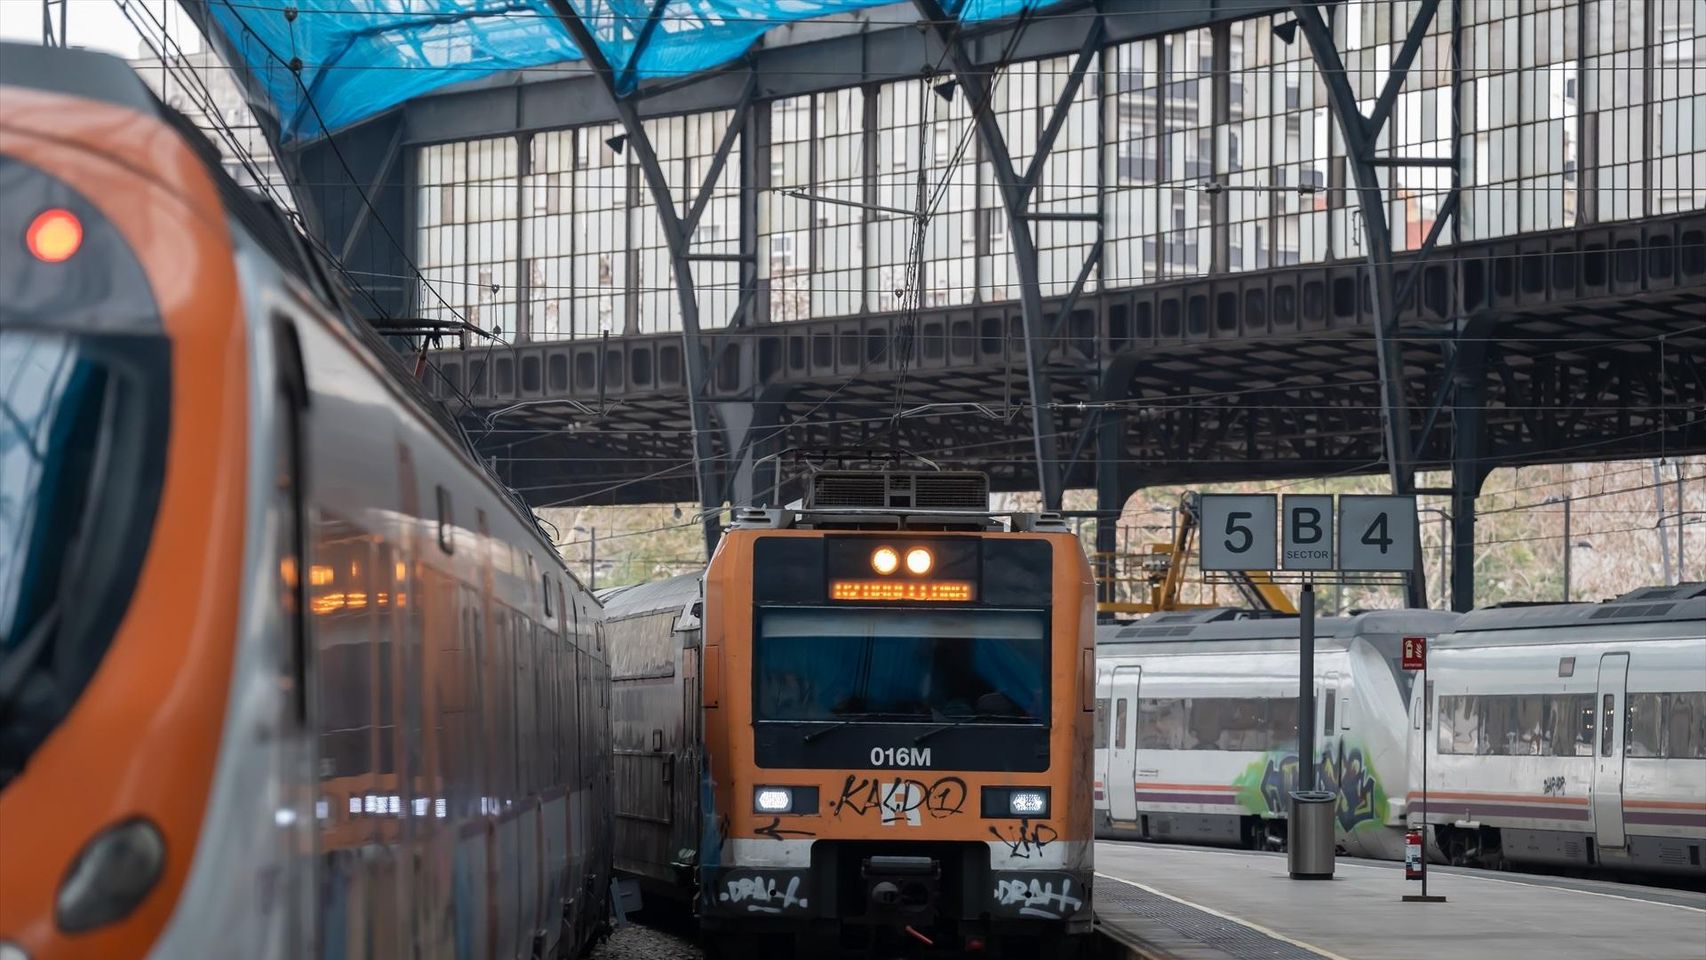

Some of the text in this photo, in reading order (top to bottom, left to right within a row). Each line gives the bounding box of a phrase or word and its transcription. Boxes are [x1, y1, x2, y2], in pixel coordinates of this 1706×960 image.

[1223, 511, 1254, 554] 5
[1291, 507, 1323, 544] B
[1360, 511, 1394, 554] 4
[1286, 550, 1329, 559] SECTOR
[870, 746, 931, 767] 016M
